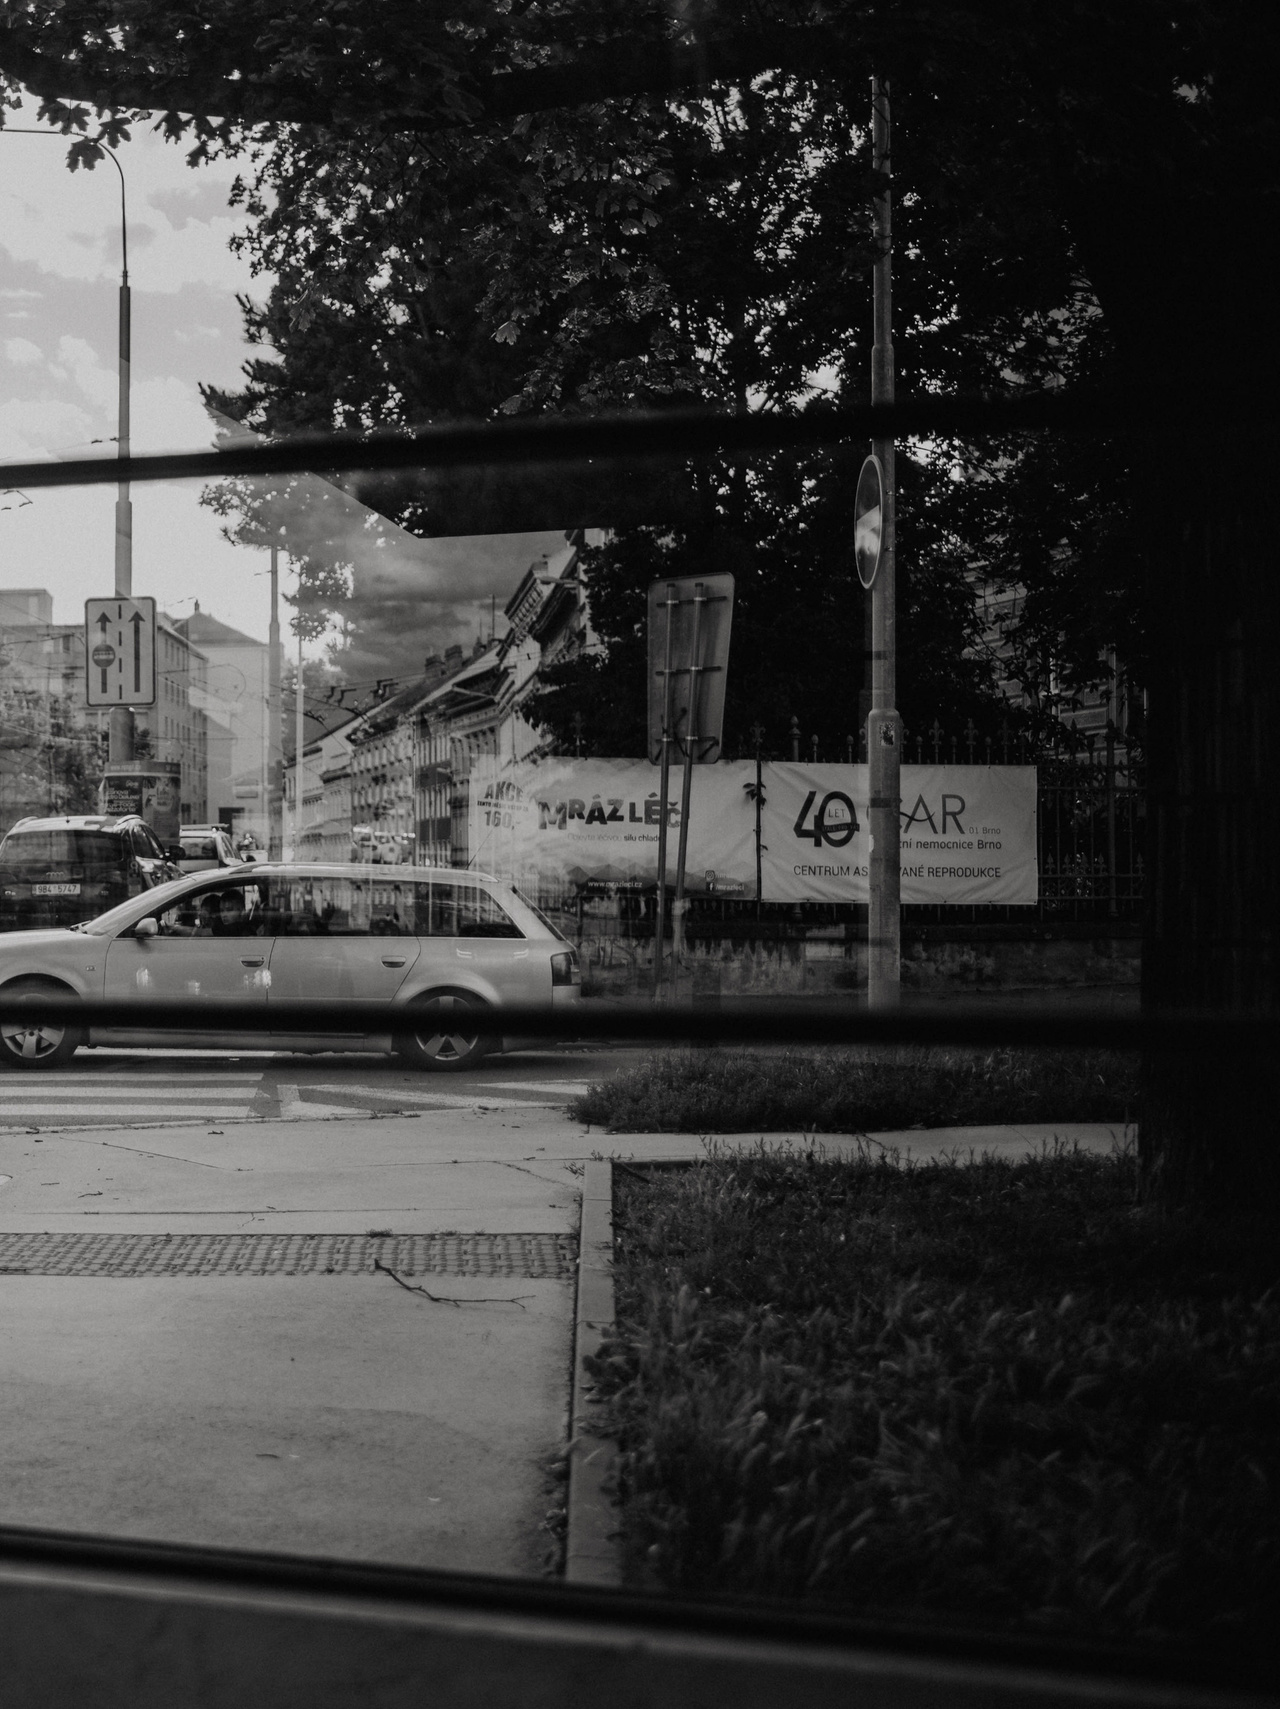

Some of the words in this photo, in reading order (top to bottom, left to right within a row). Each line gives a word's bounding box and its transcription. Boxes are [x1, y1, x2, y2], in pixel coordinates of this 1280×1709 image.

[484, 781, 524, 803] AKCE
[538, 794, 625, 830] MRÁZ
[828, 808, 845, 818] LET
[793, 791, 857, 848] 40
[982, 826, 1001, 835] Brno
[624, 834, 637, 842] silu
[916, 839, 973, 849] nemocnice
[977, 839, 1002, 850] Brno
[793, 865, 850, 877] CENTRUM
[927, 866, 1001, 878] REPRODUKCE
[57, 884, 77, 894] 5747
